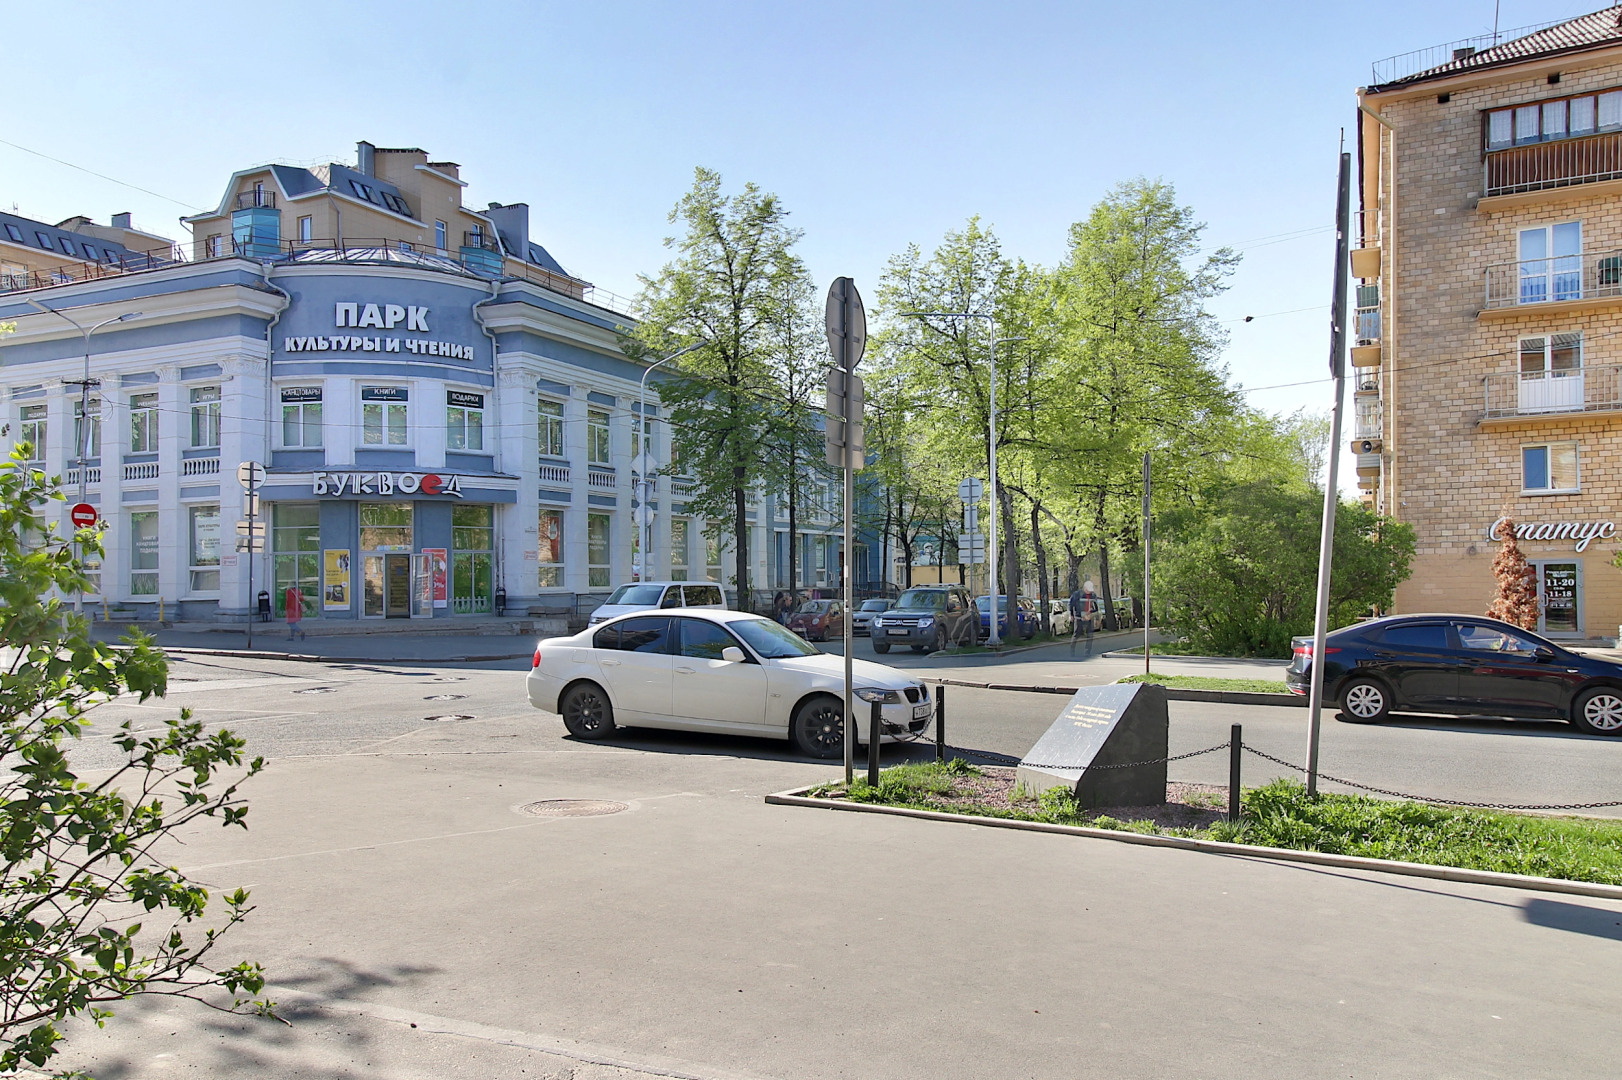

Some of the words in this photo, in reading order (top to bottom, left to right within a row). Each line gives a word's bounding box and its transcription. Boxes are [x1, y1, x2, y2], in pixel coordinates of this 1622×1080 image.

[335, 302, 430, 332] ПАРК
[284, 335, 380, 352] КУЛЬТУРЫ
[385, 337, 399, 352] И
[405, 338, 474, 361] ЧТЕНИЯ
[452, 392, 479, 402] ПОДАРКИ
[1546, 578, 1575, 587] 11-20
